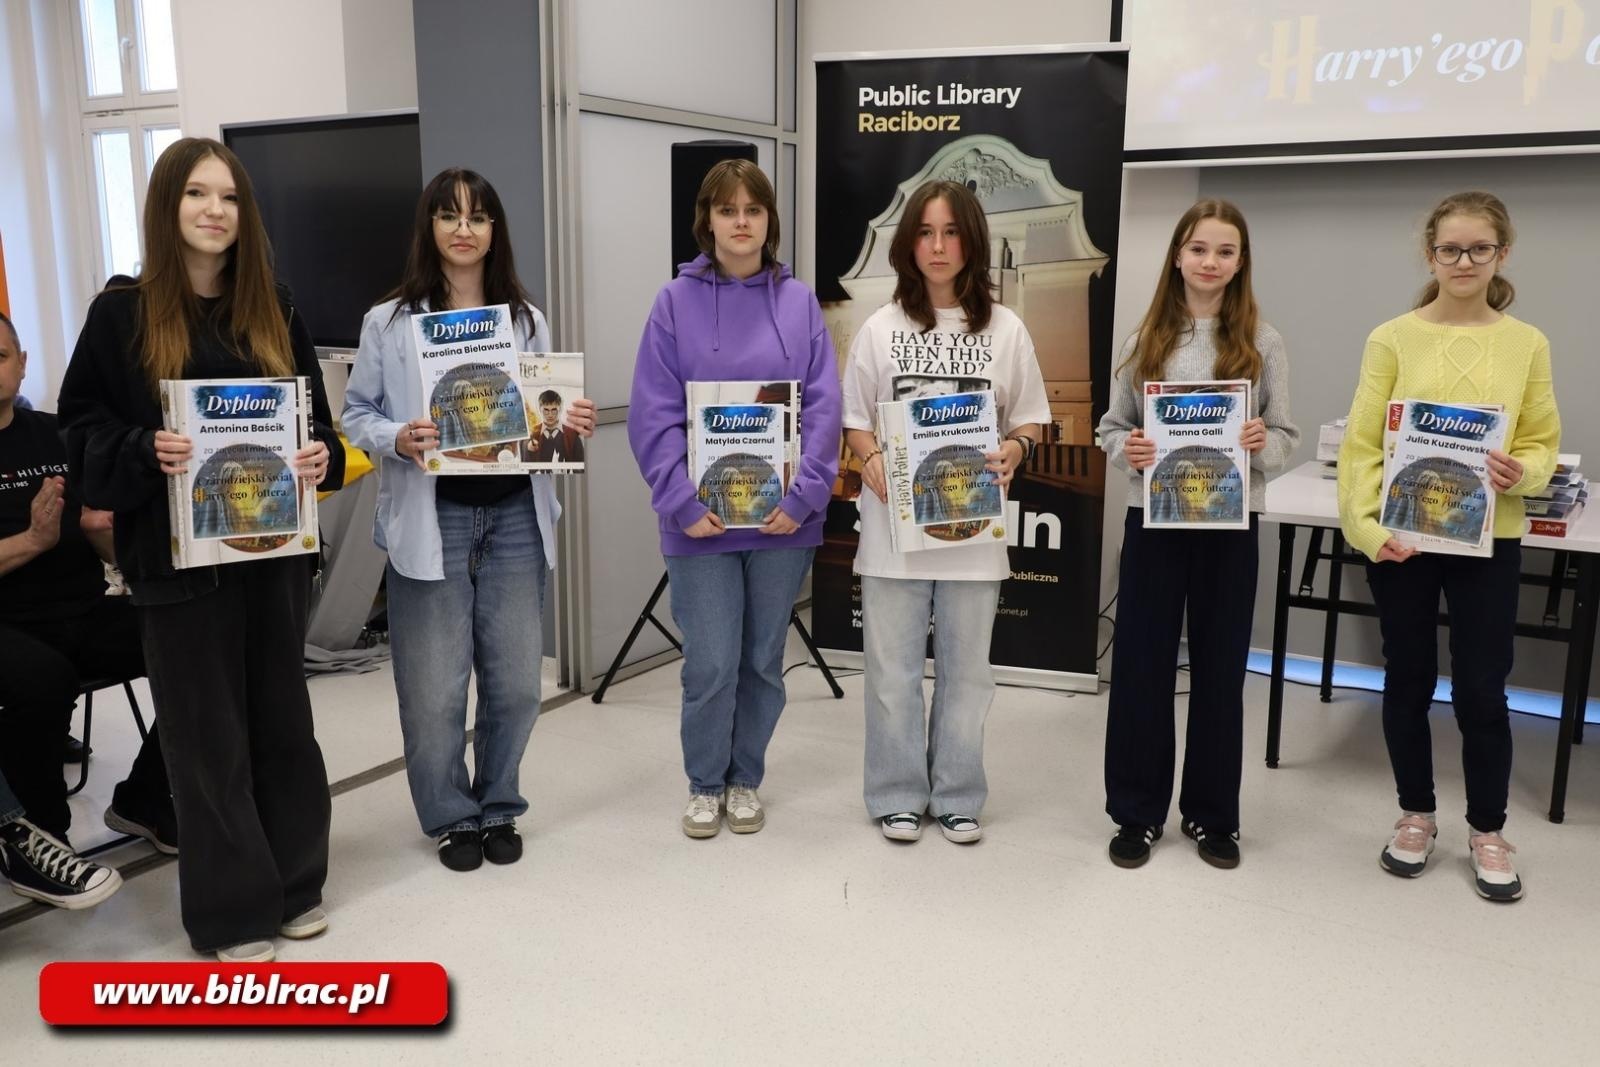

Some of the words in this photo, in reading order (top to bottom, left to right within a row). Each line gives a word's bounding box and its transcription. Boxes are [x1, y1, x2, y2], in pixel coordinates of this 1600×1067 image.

[858, 84, 931, 107] Public
[937, 82, 1022, 109] Library
[858, 110, 961, 133] Raciborz
[433, 318, 496, 339] Dyplom
[891, 331, 943, 346] HAVE
[950, 333, 993, 347] YOU
[422, 347, 463, 359] Karolina
[464, 341, 512, 354] Bielawska
[890, 345, 940, 360] SEEN
[946, 347, 993, 362] THIS
[897, 359, 985, 375] WIZARD?
[206, 393, 277, 414] Dyplom
[920, 402, 979, 423] Dyplom
[1164, 402, 1228, 421] Dyplom
[200, 424, 249, 434] Antonina
[251, 422, 285, 433] Baścik
[711, 412, 769, 430] Dyplom
[1419, 411, 1488, 436] Dyplom
[912, 430, 940, 440] Emilia
[941, 425, 990, 437] Krukowska
[1168, 428, 1200, 437] Hanna
[1201, 427, 1223, 436] Galli
[1405, 434, 1430, 446] Julia
[705, 437, 741, 447] Matylda
[742, 436, 775, 445] Czarnul
